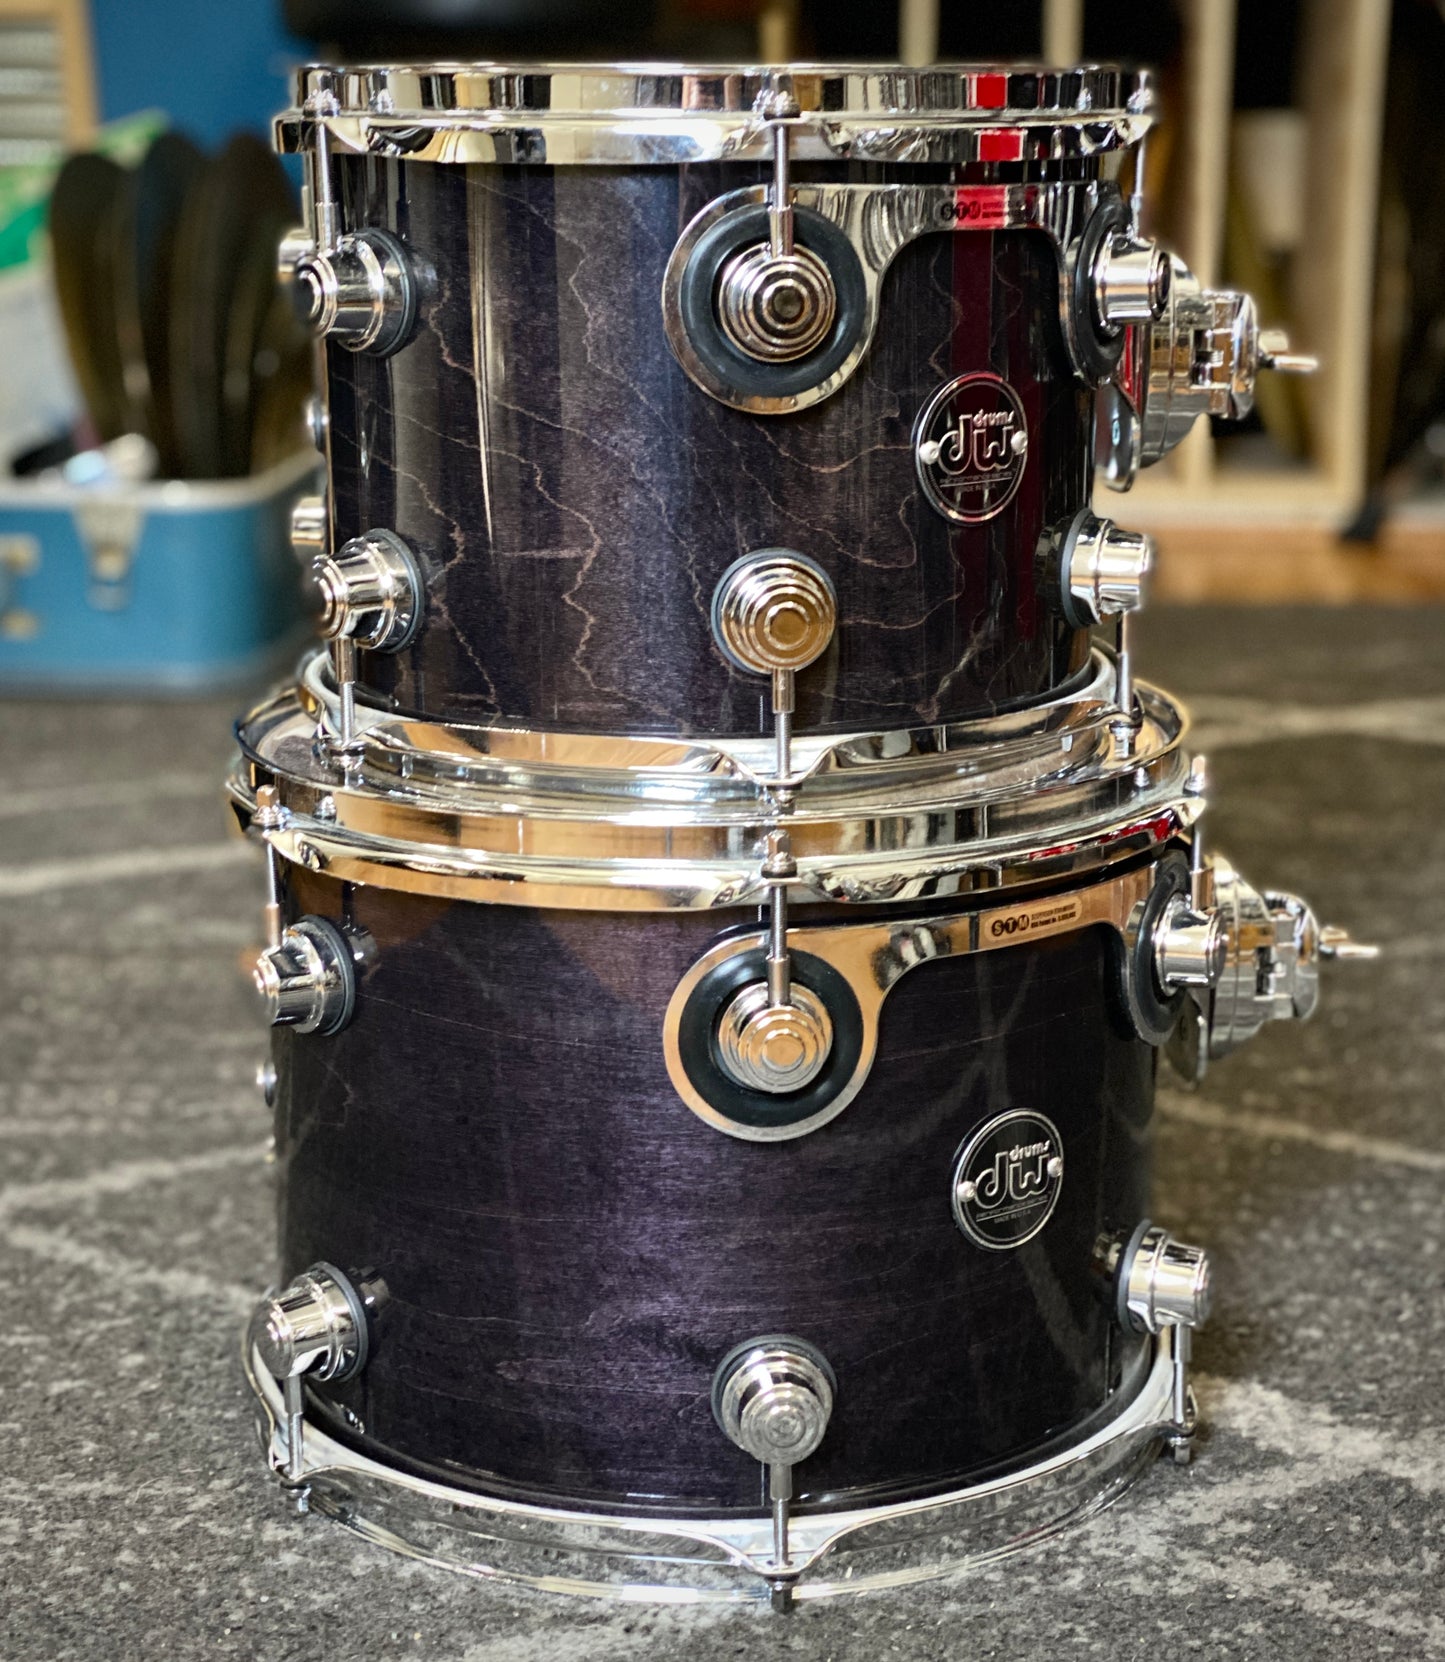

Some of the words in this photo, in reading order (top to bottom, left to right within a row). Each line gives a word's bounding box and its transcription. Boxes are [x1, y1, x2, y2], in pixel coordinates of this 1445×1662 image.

[941, 201, 981, 221] STM
[972, 408, 1015, 427] drums
[937, 414, 1015, 476] dw
[992, 914, 1030, 937] STM
[1009, 1140, 1050, 1162] drums
[975, 1151, 1050, 1209] dw
